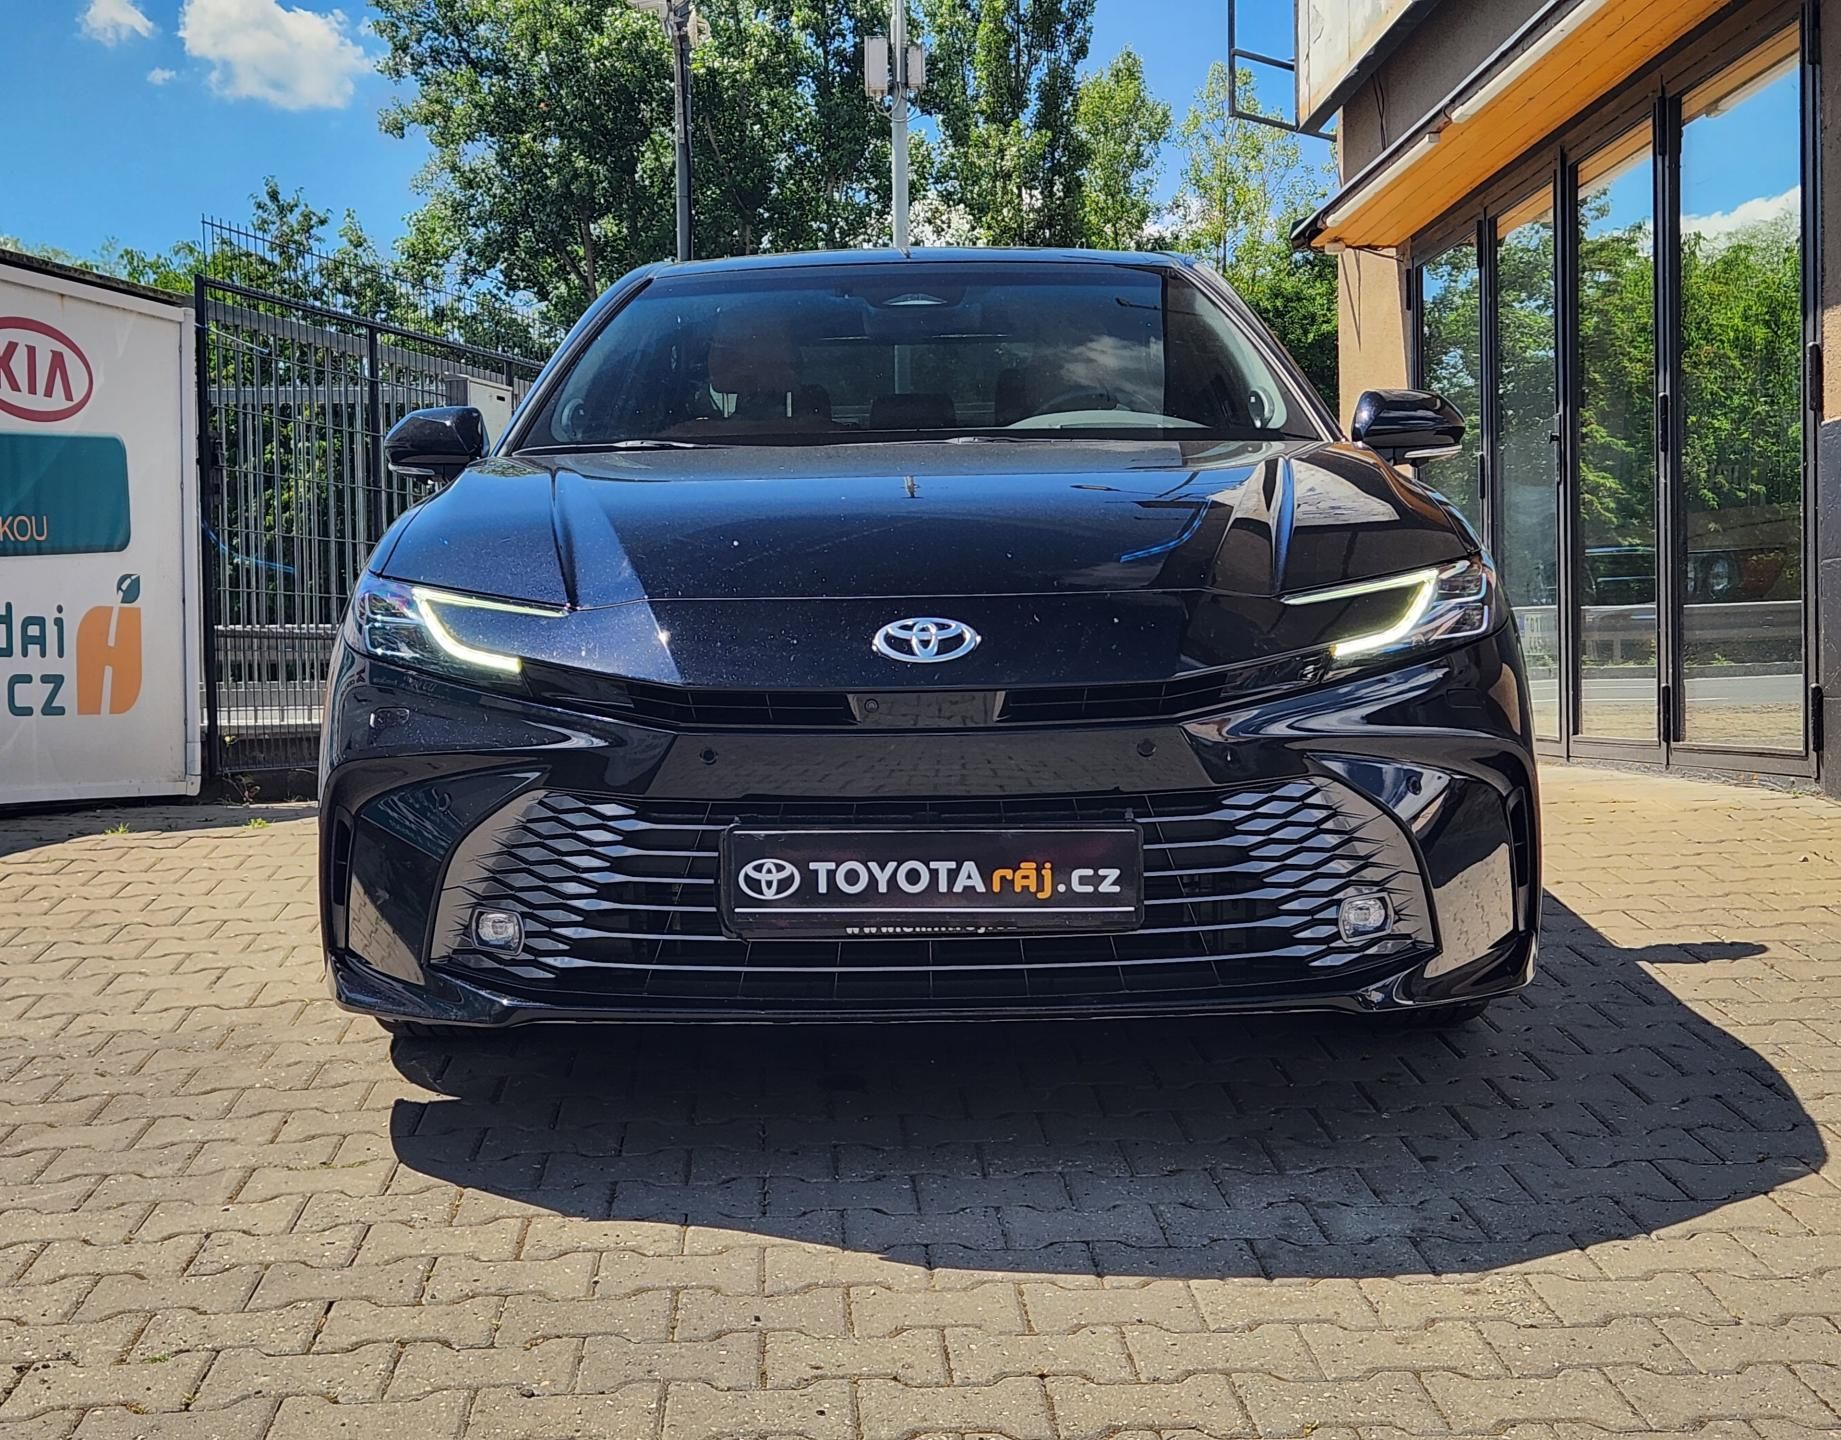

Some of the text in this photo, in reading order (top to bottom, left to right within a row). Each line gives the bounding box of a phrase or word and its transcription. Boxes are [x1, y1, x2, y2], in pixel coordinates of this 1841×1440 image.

[0, 341, 74, 402] KIA
[0, 516, 48, 541] KOU
[809, 860, 986, 894] TOYOTA
